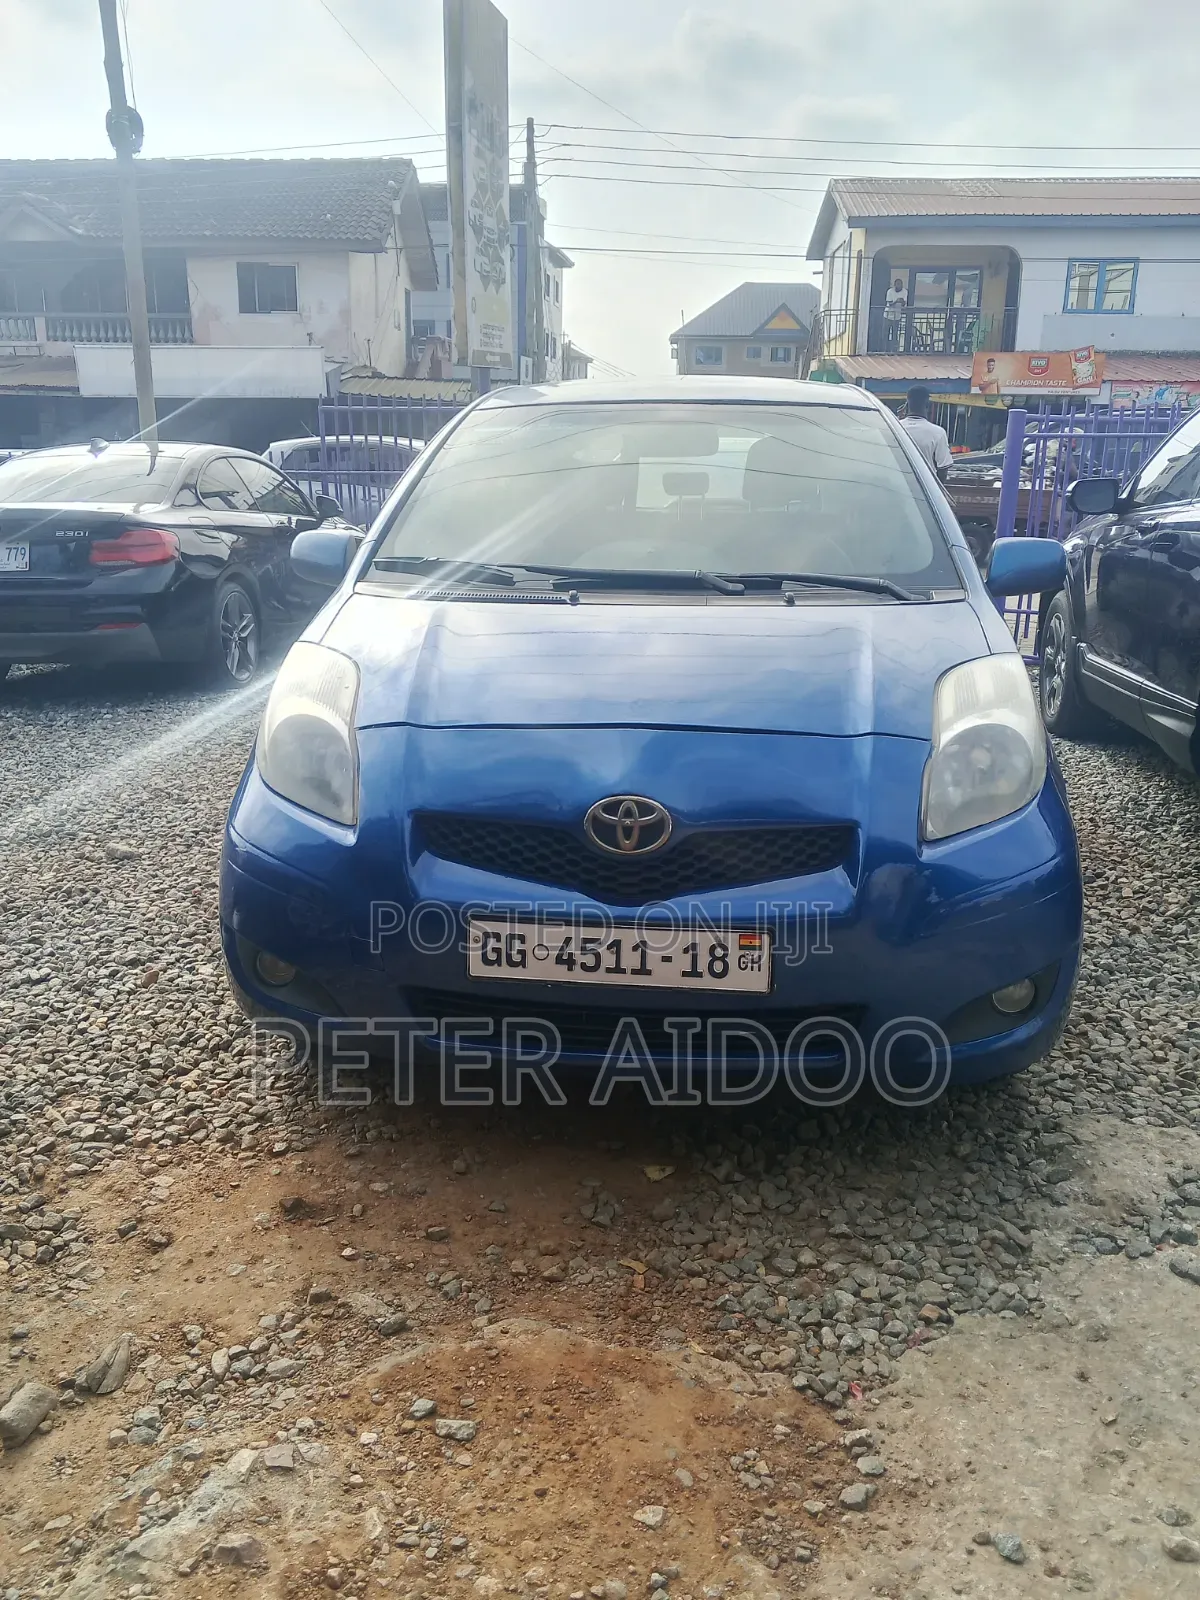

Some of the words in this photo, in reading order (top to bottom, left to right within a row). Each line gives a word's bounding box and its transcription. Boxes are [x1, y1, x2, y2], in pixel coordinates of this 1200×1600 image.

[5, 547, 26, 561] 779
[481, 931, 528, 968] GG
[737, 953, 762, 972] GH
